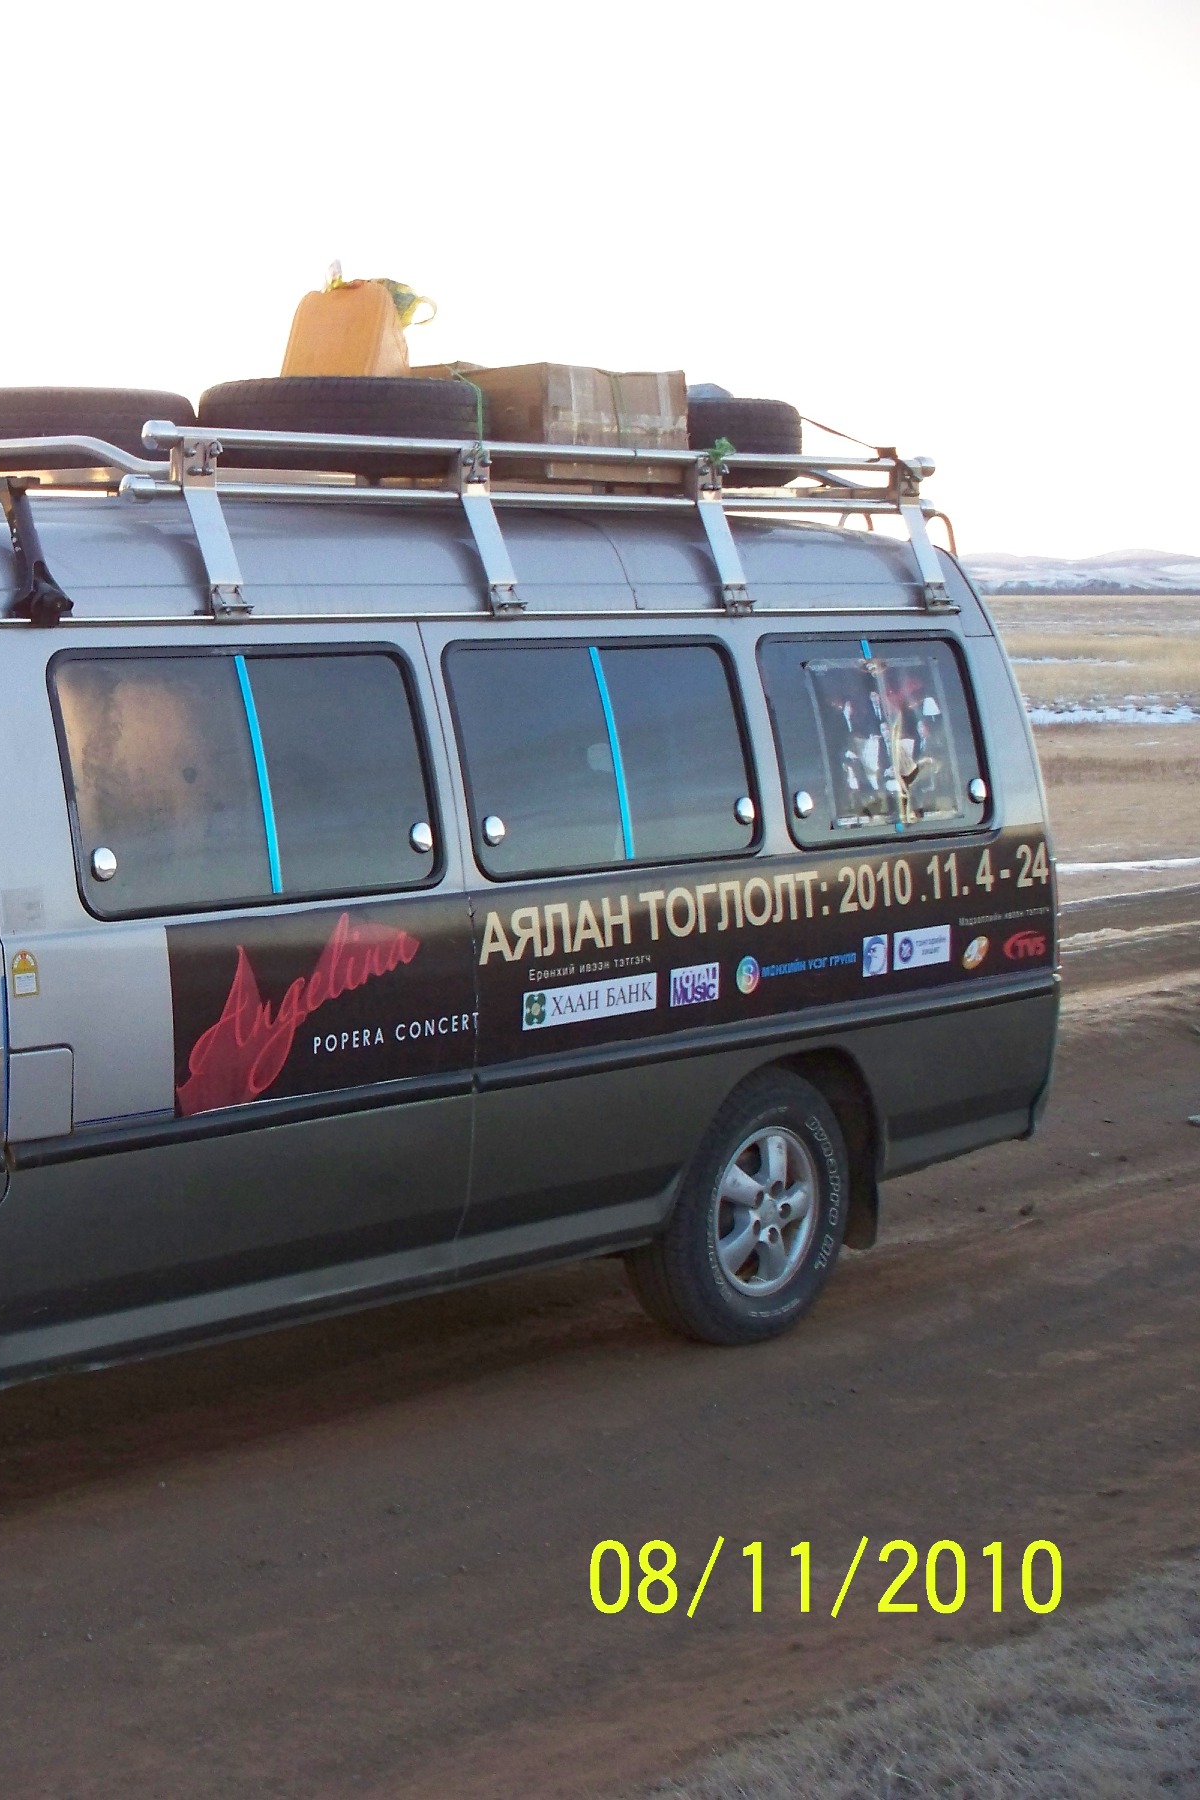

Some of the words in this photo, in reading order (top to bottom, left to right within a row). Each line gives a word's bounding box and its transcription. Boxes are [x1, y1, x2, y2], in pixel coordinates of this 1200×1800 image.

[478, 894, 632, 966] АЯЛАН
[638, 870, 831, 941] ТОГЛОЛТ:
[837, 858, 913, 914] 2010
[579, 962, 611, 975] ивээн
[550, 989, 600, 1018] ХААН
[606, 981, 653, 1008] БАНК
[313, 1027, 385, 1055] POPERA
[395, 1012, 480, 1042] CONCERT
